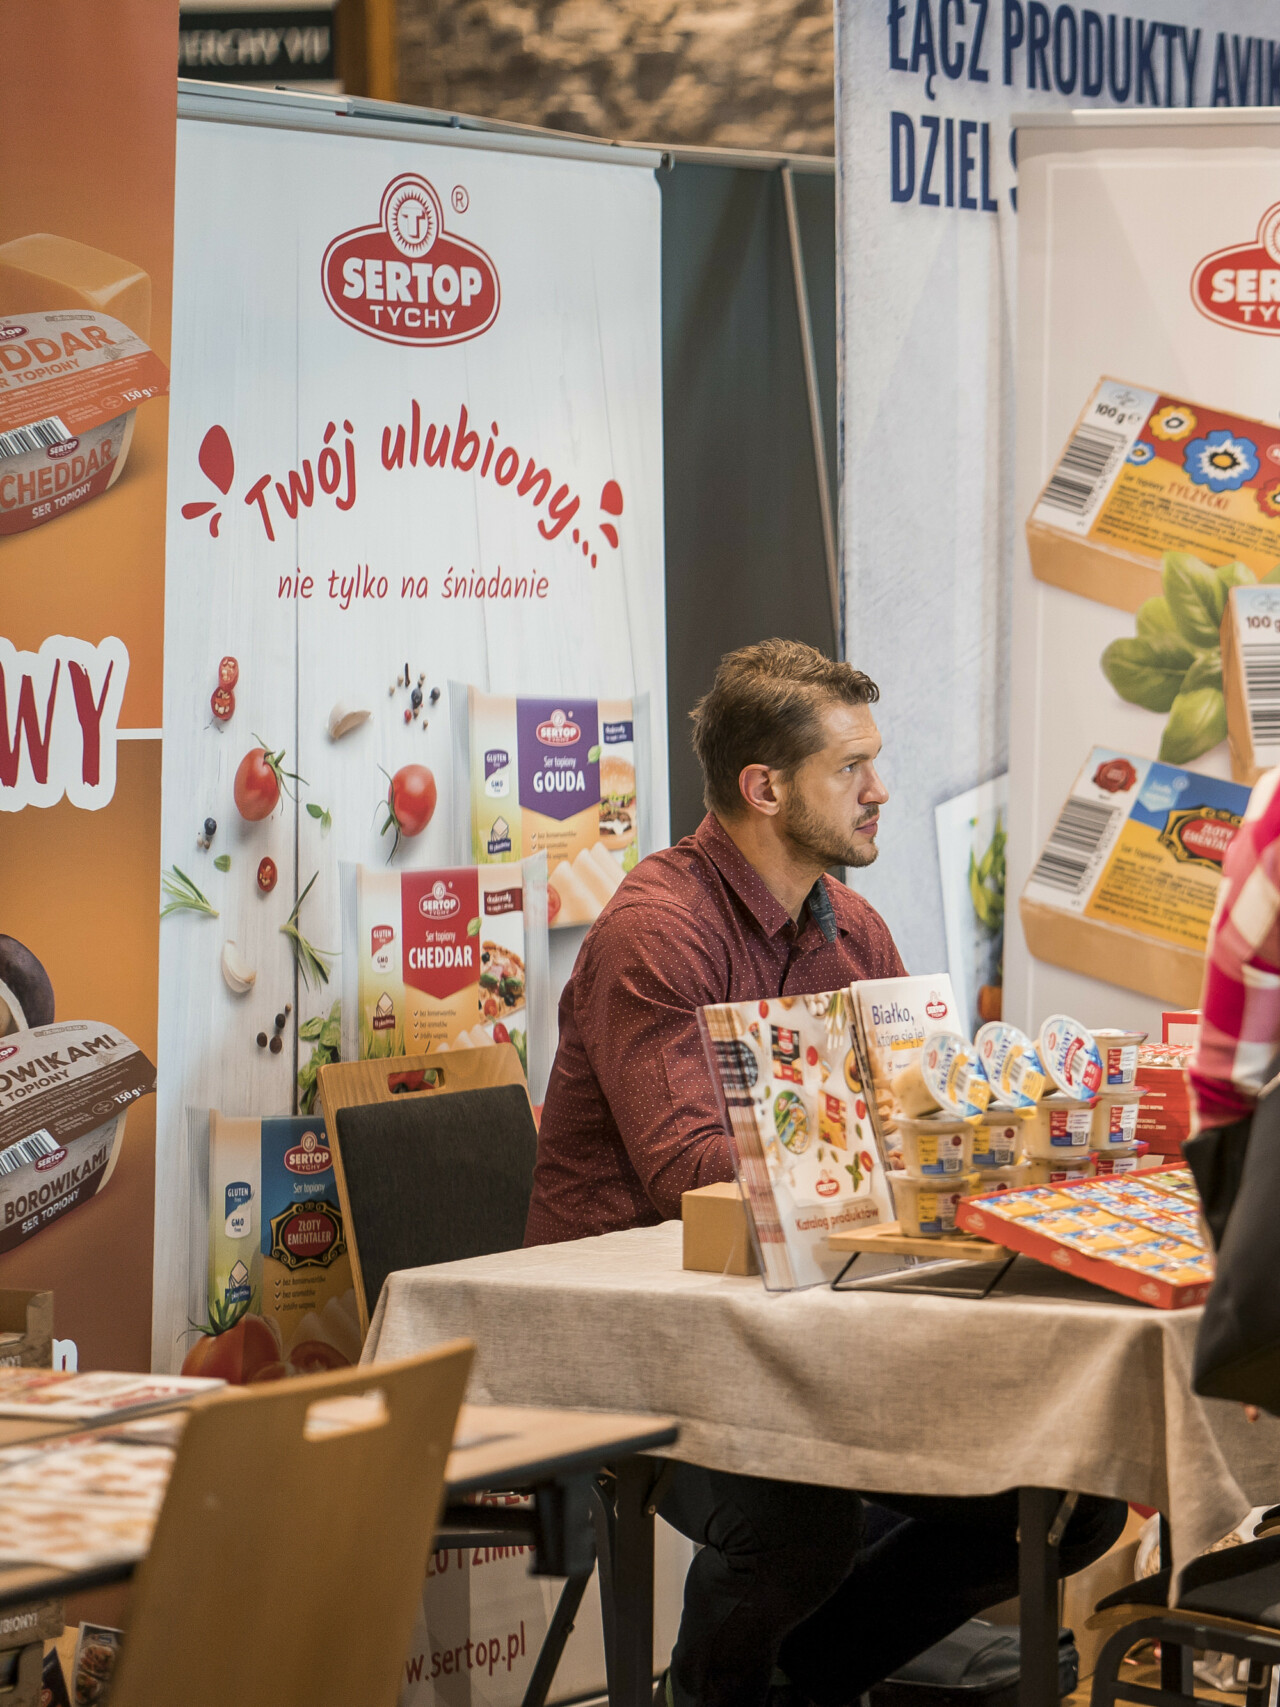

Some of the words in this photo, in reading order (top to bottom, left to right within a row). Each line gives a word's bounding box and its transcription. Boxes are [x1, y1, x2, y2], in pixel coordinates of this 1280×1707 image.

[887, 0, 990, 101] ŁĄCZ
[1002, 0, 1203, 108] PRODUKTY
[890, 111, 999, 212] DZIEL
[342, 256, 483, 307] SERTOP
[369, 304, 456, 330] TYCHY
[0, 326, 116, 374] DDAR
[12, 358, 80, 384] TOPIONY
[122, 388, 142, 402] 150
[1095, 402, 1117, 419] 100
[1116, 412, 1126, 424] g
[49, 439, 78, 455] SERTOP
[0, 438, 113, 509] CHEDDAR
[244, 419, 357, 542] Twój
[32, 502, 51, 520] SER
[54, 481, 92, 509] TOPIONY
[278, 566, 314, 599] nie
[327, 563, 388, 610] tylko
[400, 574, 428, 599] na
[441, 565, 549, 599] śniadanie
[1247, 616, 1271, 629] 100
[486, 753, 507, 763] GLUTEN
[543, 756, 555, 768] Ser
[555, 756, 576, 769] topiony
[533, 770, 586, 793] GOUDA
[422, 899, 456, 911] SERTOP
[373, 929, 393, 938] GLUTEN
[425, 931, 435, 942] Ser
[435, 931, 456, 944] topiony
[377, 956, 389, 964] GMO
[408, 945, 473, 970] CHEDDAR
[872, 1002, 915, 1025] Białko,
[0, 1034, 117, 1093] OWIKAMI
[6, 1069, 69, 1102] TOPIONY
[113, 1091, 132, 1104] 150
[37, 1149, 66, 1169] SERTOP
[289, 1151, 329, 1166] SERTOP
[4, 1146, 107, 1225] BOROWIKAMI
[227, 1187, 249, 1198] GLUTEN
[293, 1182, 304, 1194] Ser
[304, 1182, 325, 1194] topiony
[21, 1215, 39, 1234] SER
[41, 1188, 80, 1221] TOPIONY
[795, 1214, 829, 1231] Katalog
[831, 1206, 878, 1228] produktów
[231, 1218, 244, 1227] GMO
[298, 1220, 321, 1232] ZŁOTY
[287, 1230, 331, 1246] EMENTALER
